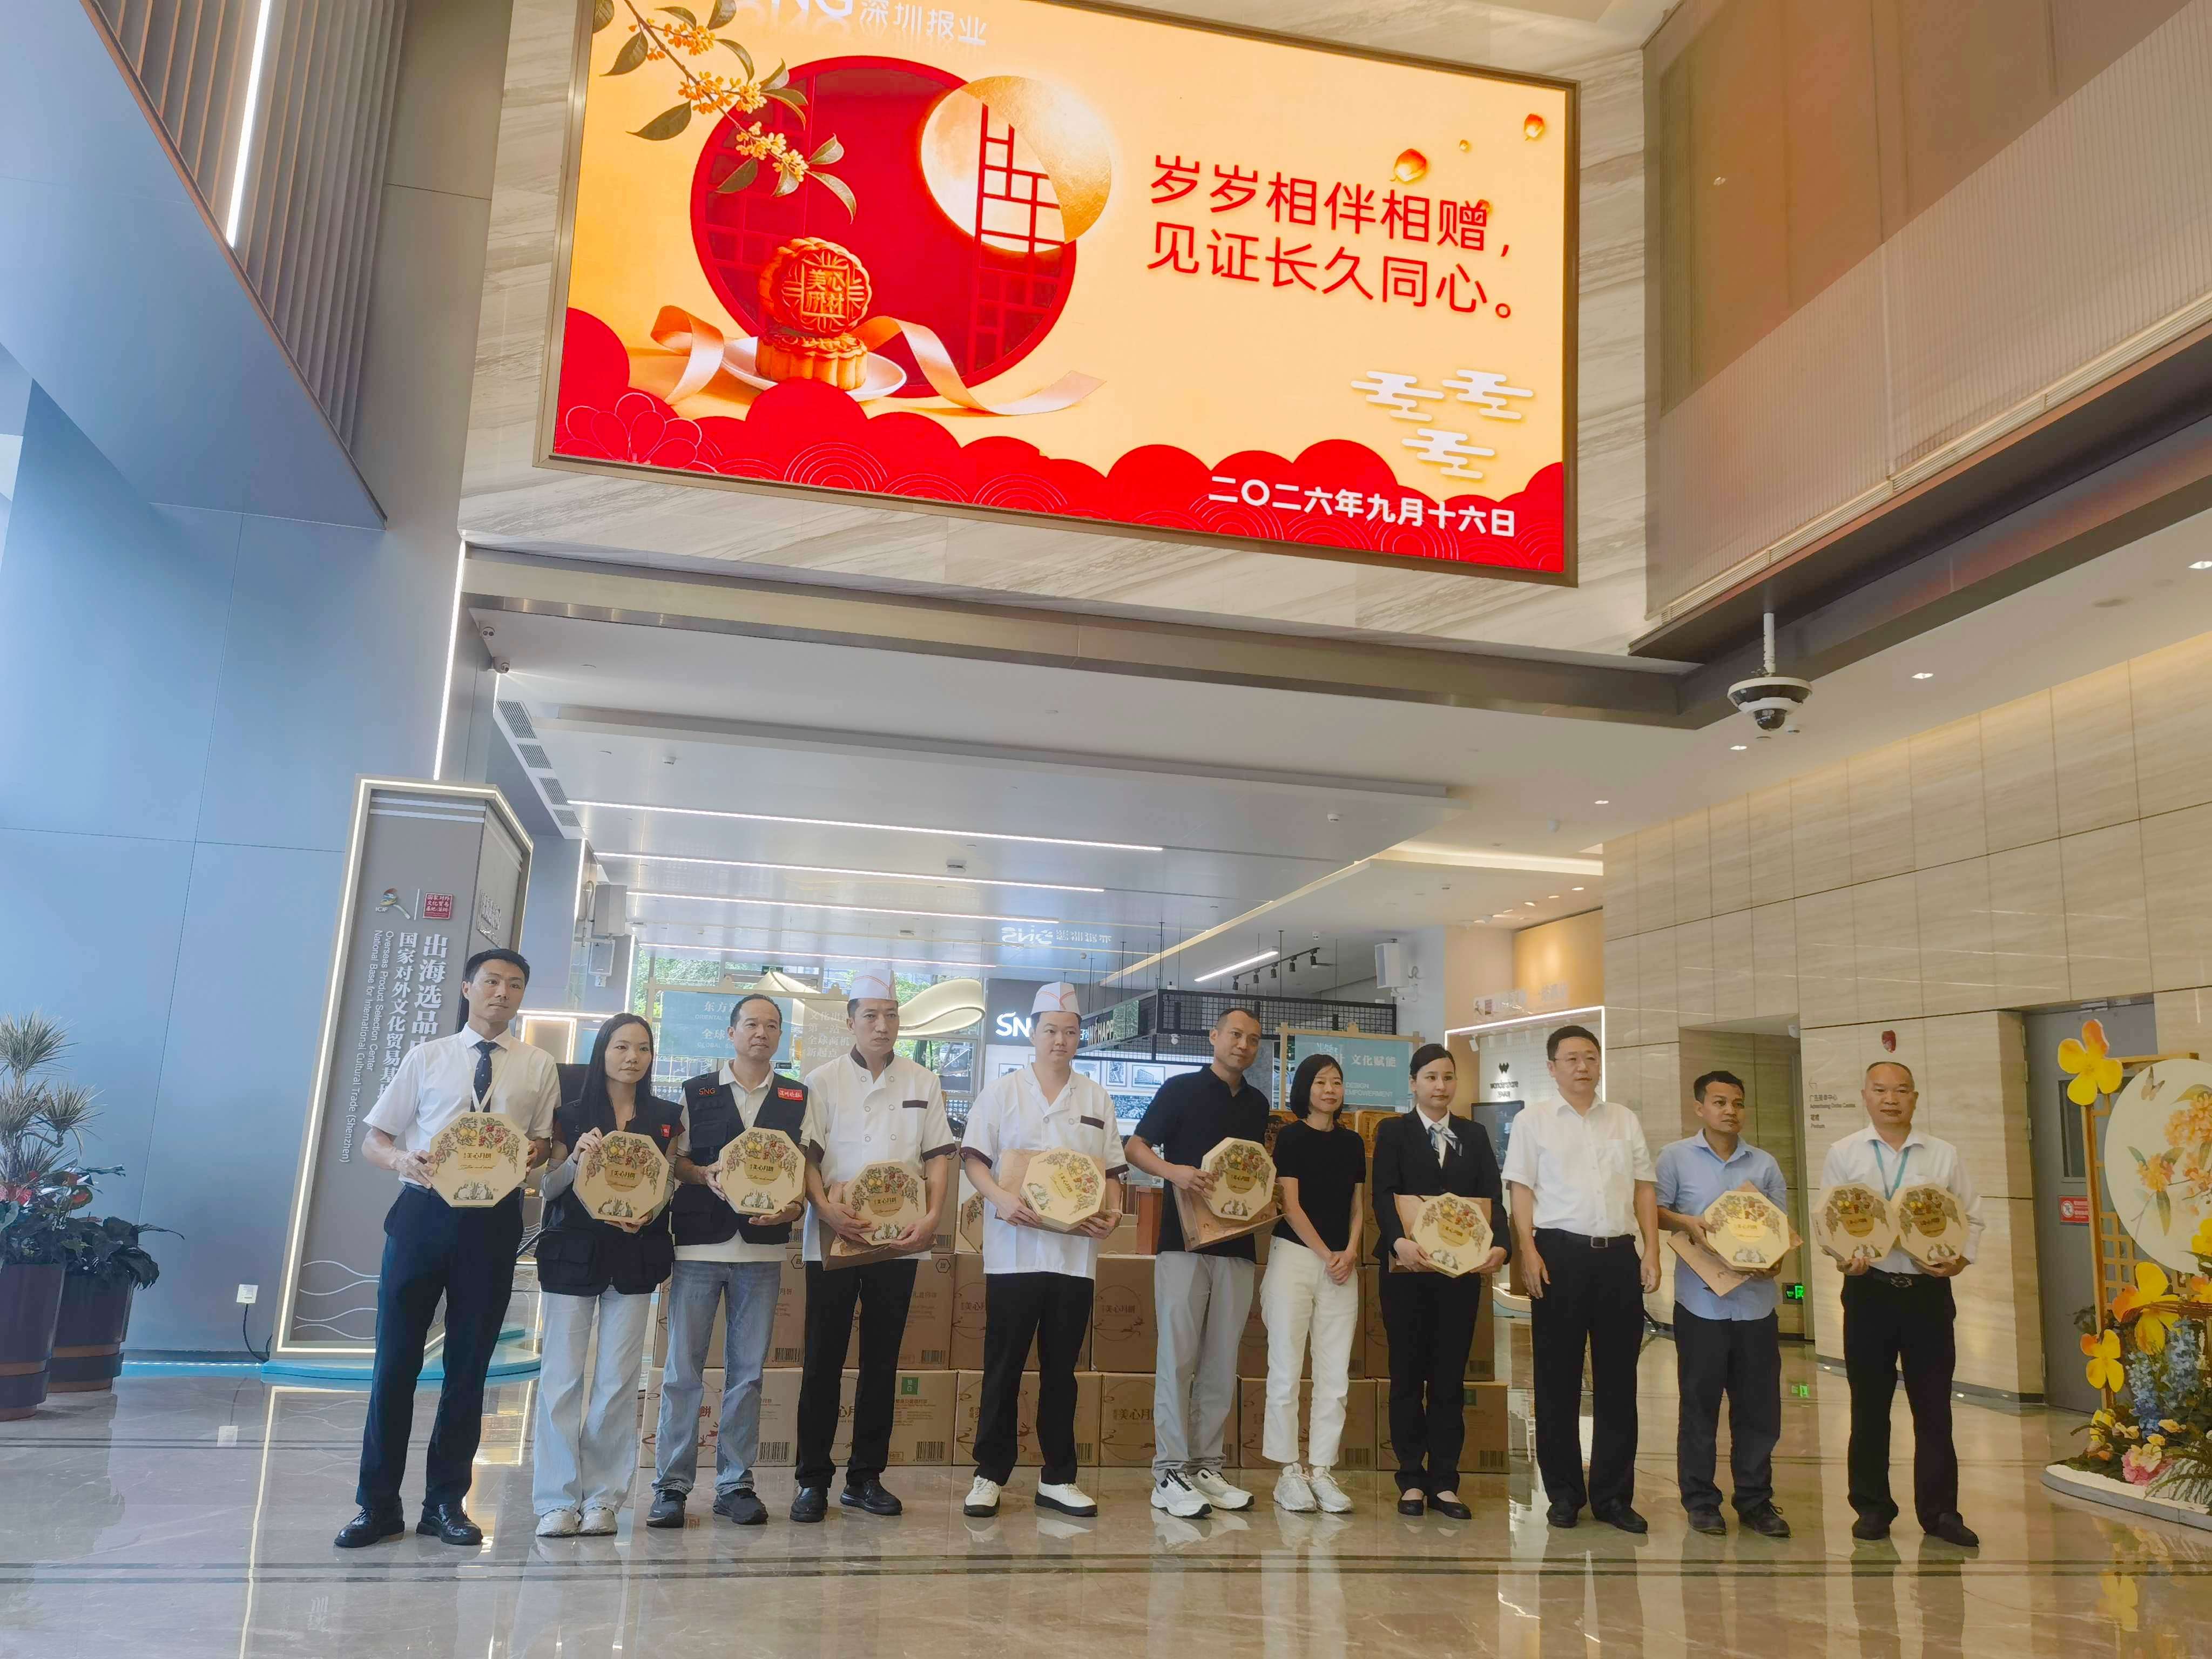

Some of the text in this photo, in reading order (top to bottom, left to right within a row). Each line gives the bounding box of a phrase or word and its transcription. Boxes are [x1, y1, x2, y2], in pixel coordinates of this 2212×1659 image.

[859, 0, 987, 45] 深圳报业
[1150, 154, 1510, 258] 岁岁相伴相赠，
[1148, 221, 1512, 319] 见证长久同心。
[367, 930, 394, 1071] Overseas Product Selection Center
[702, 1028, 726, 1040] 全球
[995, 1011, 1032, 1037] SN
[339, 930, 383, 1163] National Base for International Cultural Trade (Shenzhen)
[699, 1087, 716, 1096] SNG
